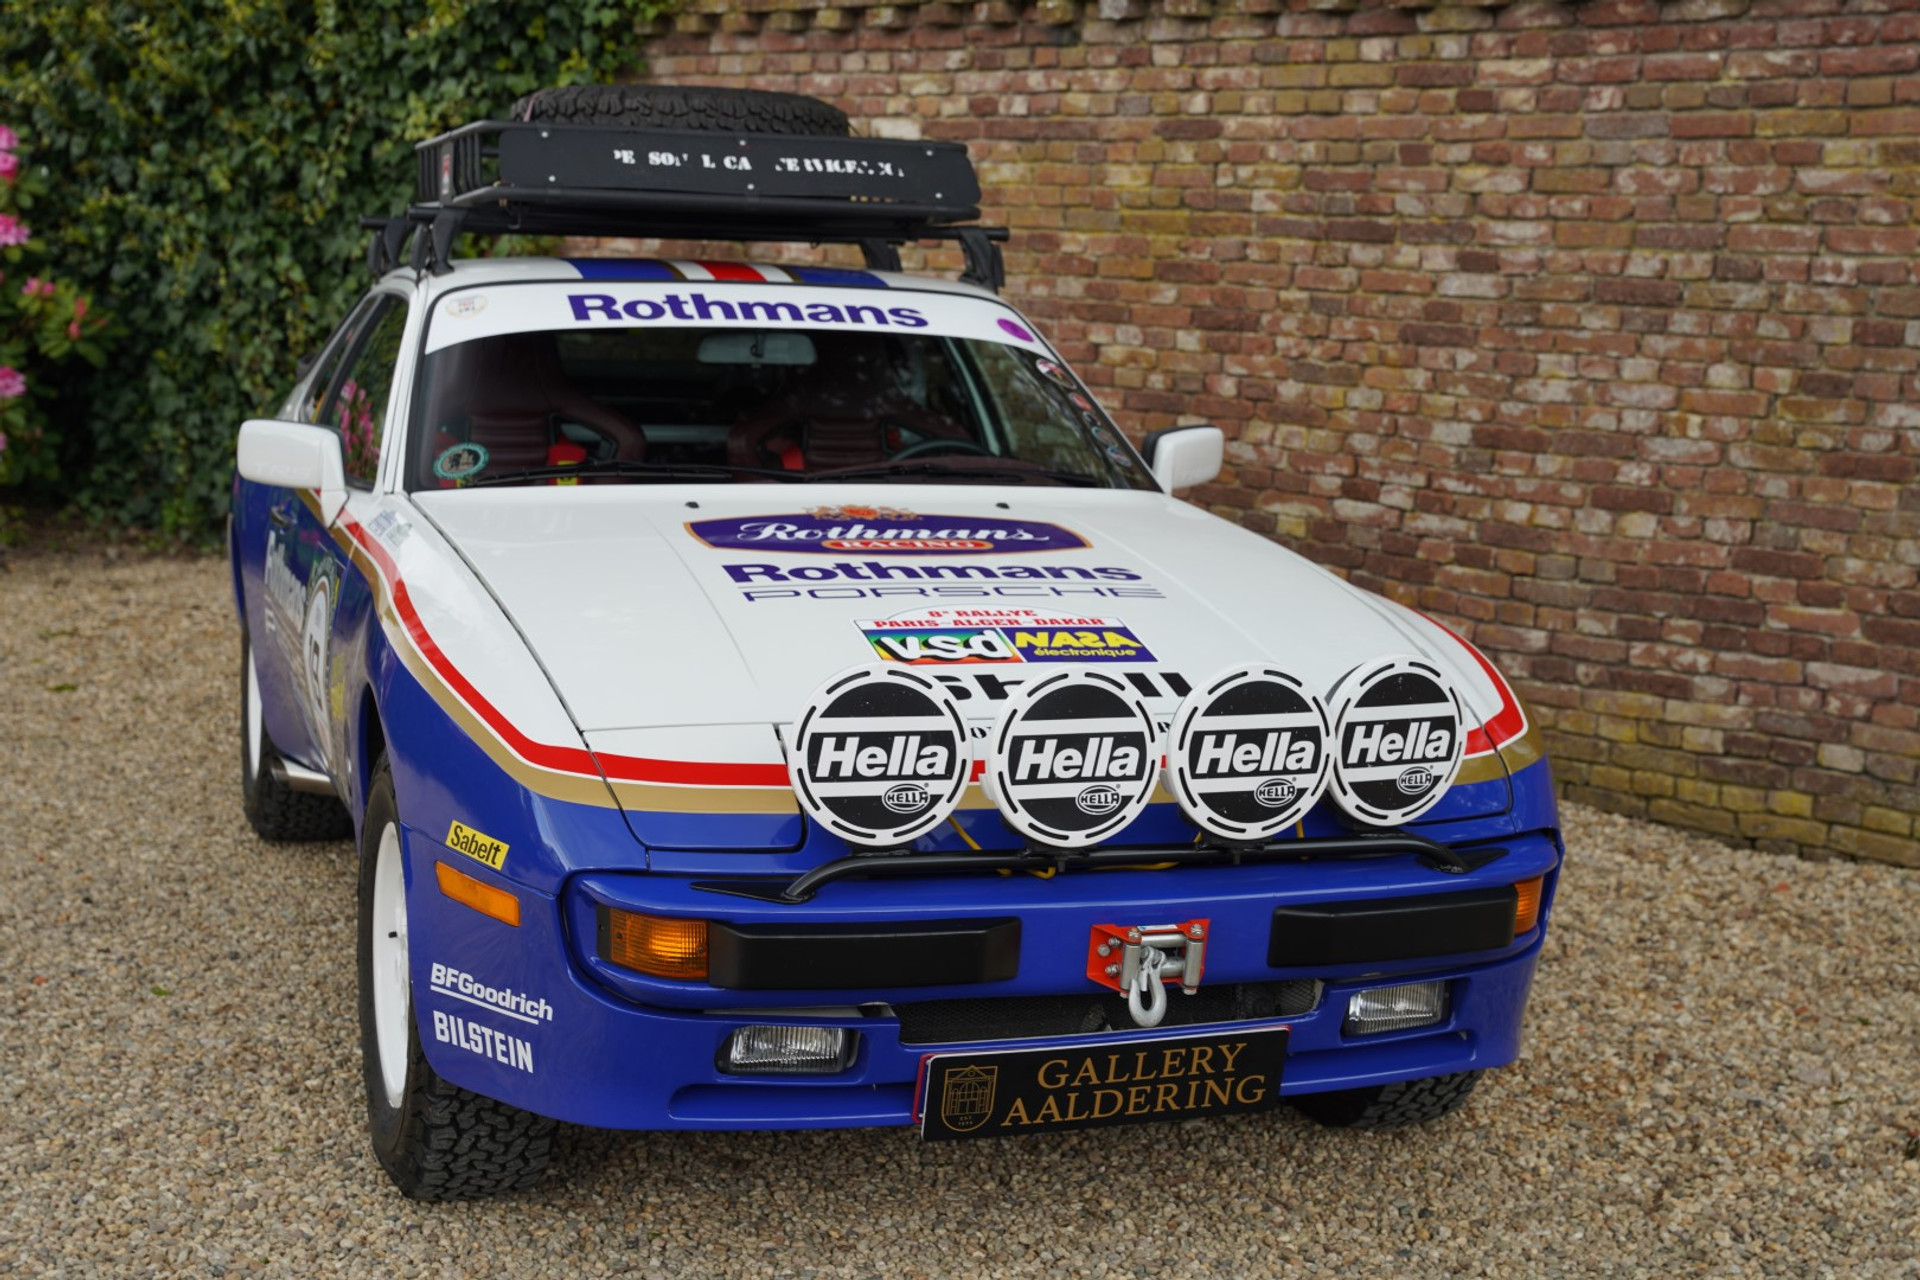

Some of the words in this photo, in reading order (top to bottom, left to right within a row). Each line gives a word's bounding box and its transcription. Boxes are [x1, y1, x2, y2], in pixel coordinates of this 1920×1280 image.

[567, 293, 929, 328] Rothmans
[737, 522, 1051, 541] Rothmans
[840, 540, 976, 550] RACING
[722, 561, 1144, 583] Rothmans
[742, 586, 1168, 602] PORSCHE
[955, 609, 1038, 617] RALLYE
[1015, 631, 1143, 648] NASA
[815, 735, 949, 778] Hella
[1195, 731, 1316, 774] Hella
[1346, 721, 1451, 765] Hella
[1014, 736, 1140, 780] Hella
[1259, 785, 1295, 797] HELLA
[1401, 773, 1432, 785] HELLA
[887, 791, 928, 804] HELLA
[1081, 792, 1120, 805] HELLA
[450, 824, 502, 866] Sabelt
[430, 962, 554, 1021] BFGoodrich
[432, 1010, 534, 1074] BILSTEIN
[1037, 1042, 1247, 1090] GALLERY
[1001, 1074, 1266, 1127] AALDERING
